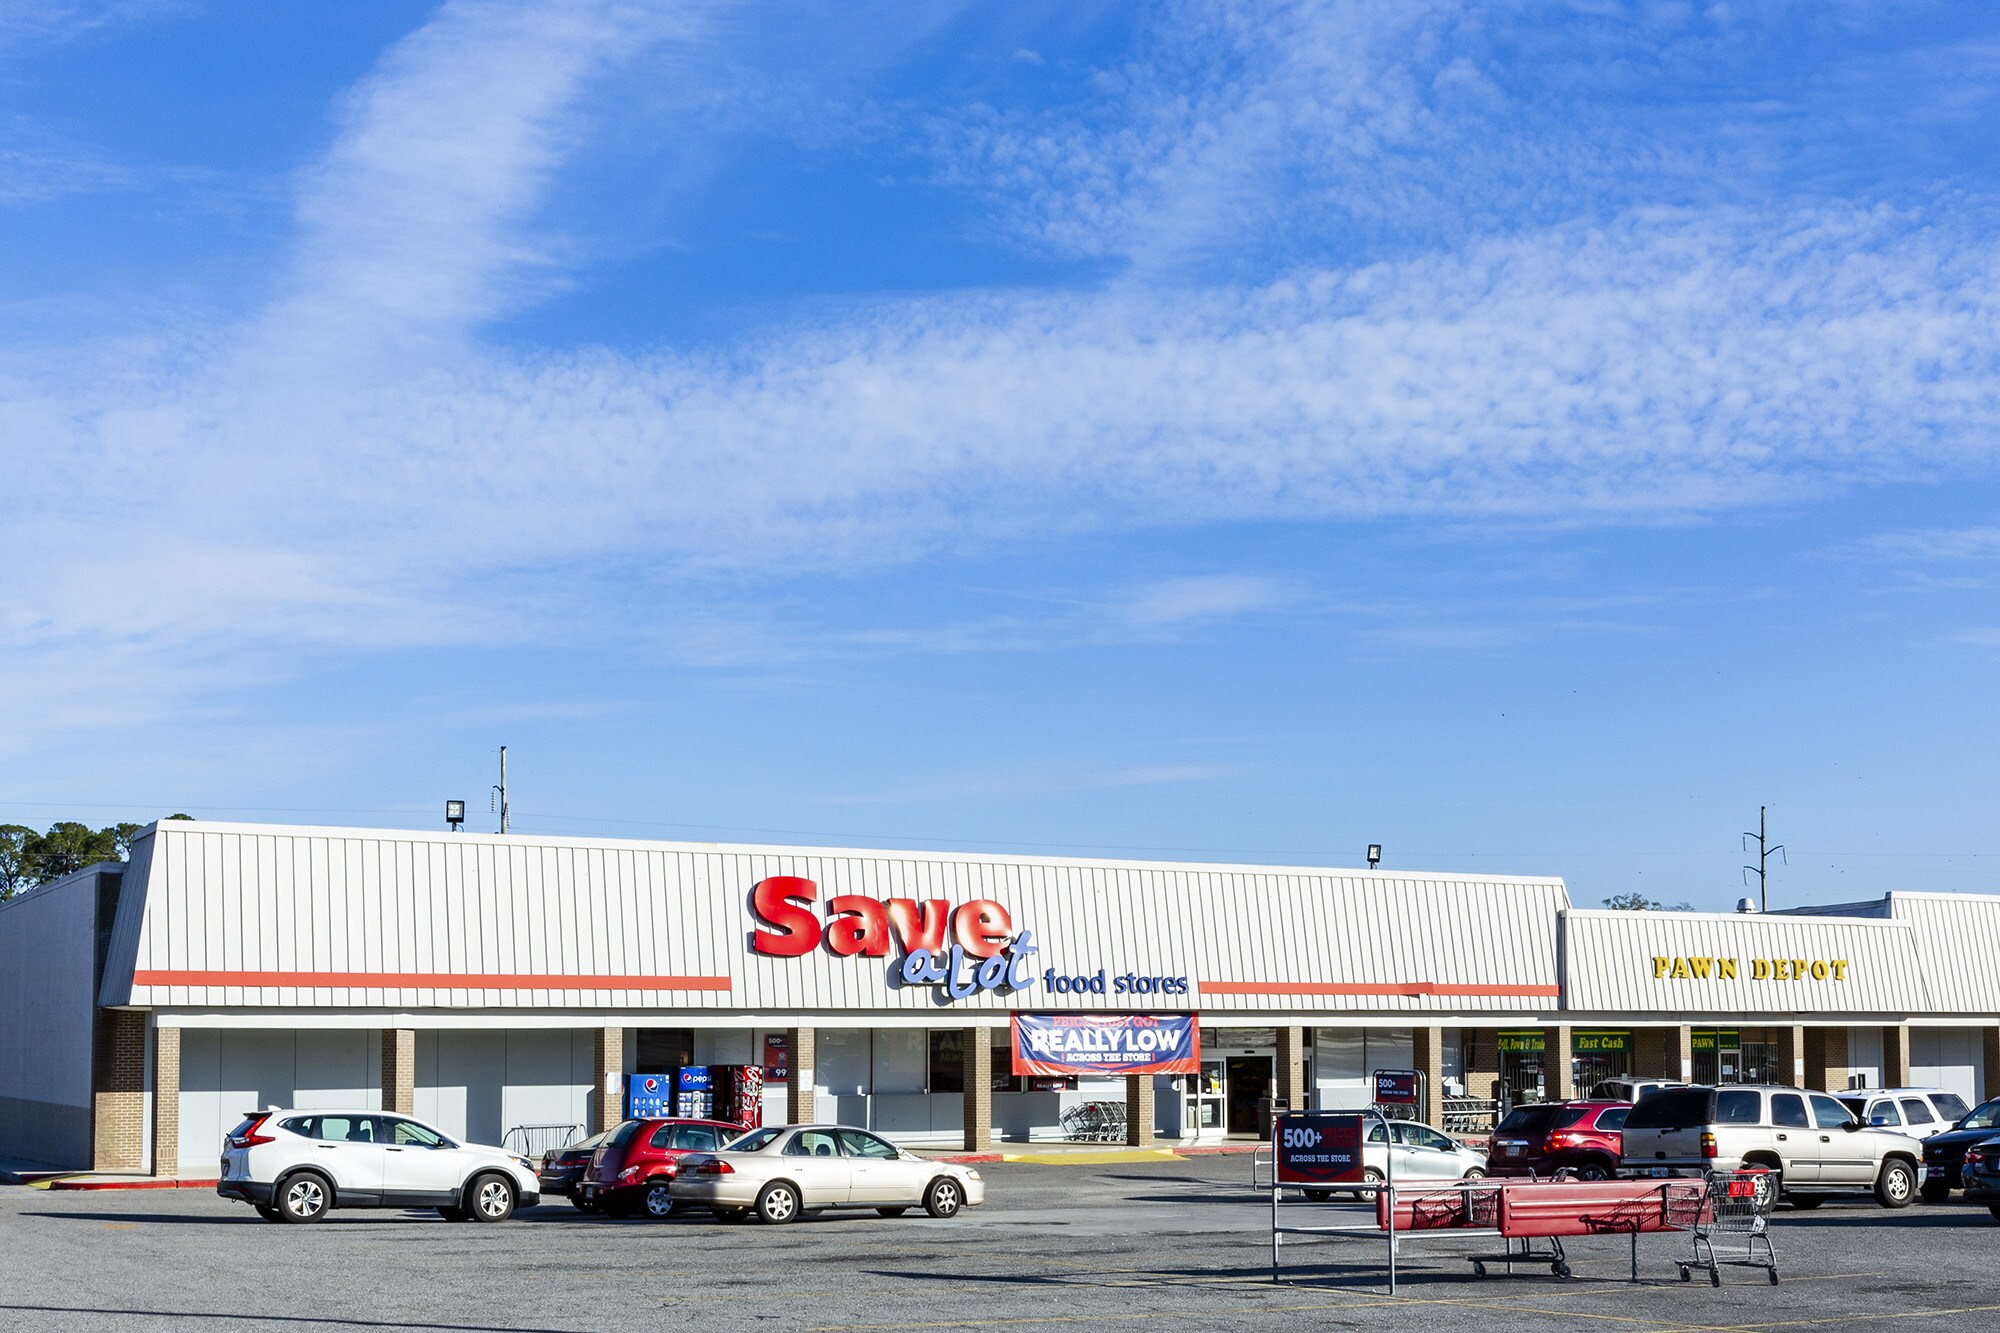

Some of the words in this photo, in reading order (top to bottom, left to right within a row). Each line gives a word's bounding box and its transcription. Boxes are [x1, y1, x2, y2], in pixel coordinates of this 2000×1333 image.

[754, 876, 1012, 958] Save
[1653, 956, 1737, 980] PAWN
[1752, 958, 1848, 980] DEPOT
[1044, 967, 1106, 994] food
[1114, 970, 1189, 995] stores
[1133, 1016, 1159, 1028] GOT
[1032, 1029, 1123, 1052] REALLY
[1126, 1028, 1181, 1052] LOW
[1578, 1037, 1598, 1049] Fast
[1601, 1037, 1624, 1049] Cash
[1692, 1038, 1715, 1048] PAWN
[1066, 1053, 1102, 1062] ACROSS
[1103, 1053, 1121, 1062] THE
[1122, 1053, 1151, 1062] STORE
[1378, 1078, 1396, 1089] 500+
[1283, 1128, 1323, 1148] 500+
[1290, 1154, 1316, 1163] ACROSS
[1317, 1154, 1329, 1163] THE
[1330, 1154, 1351, 1163] STORE
